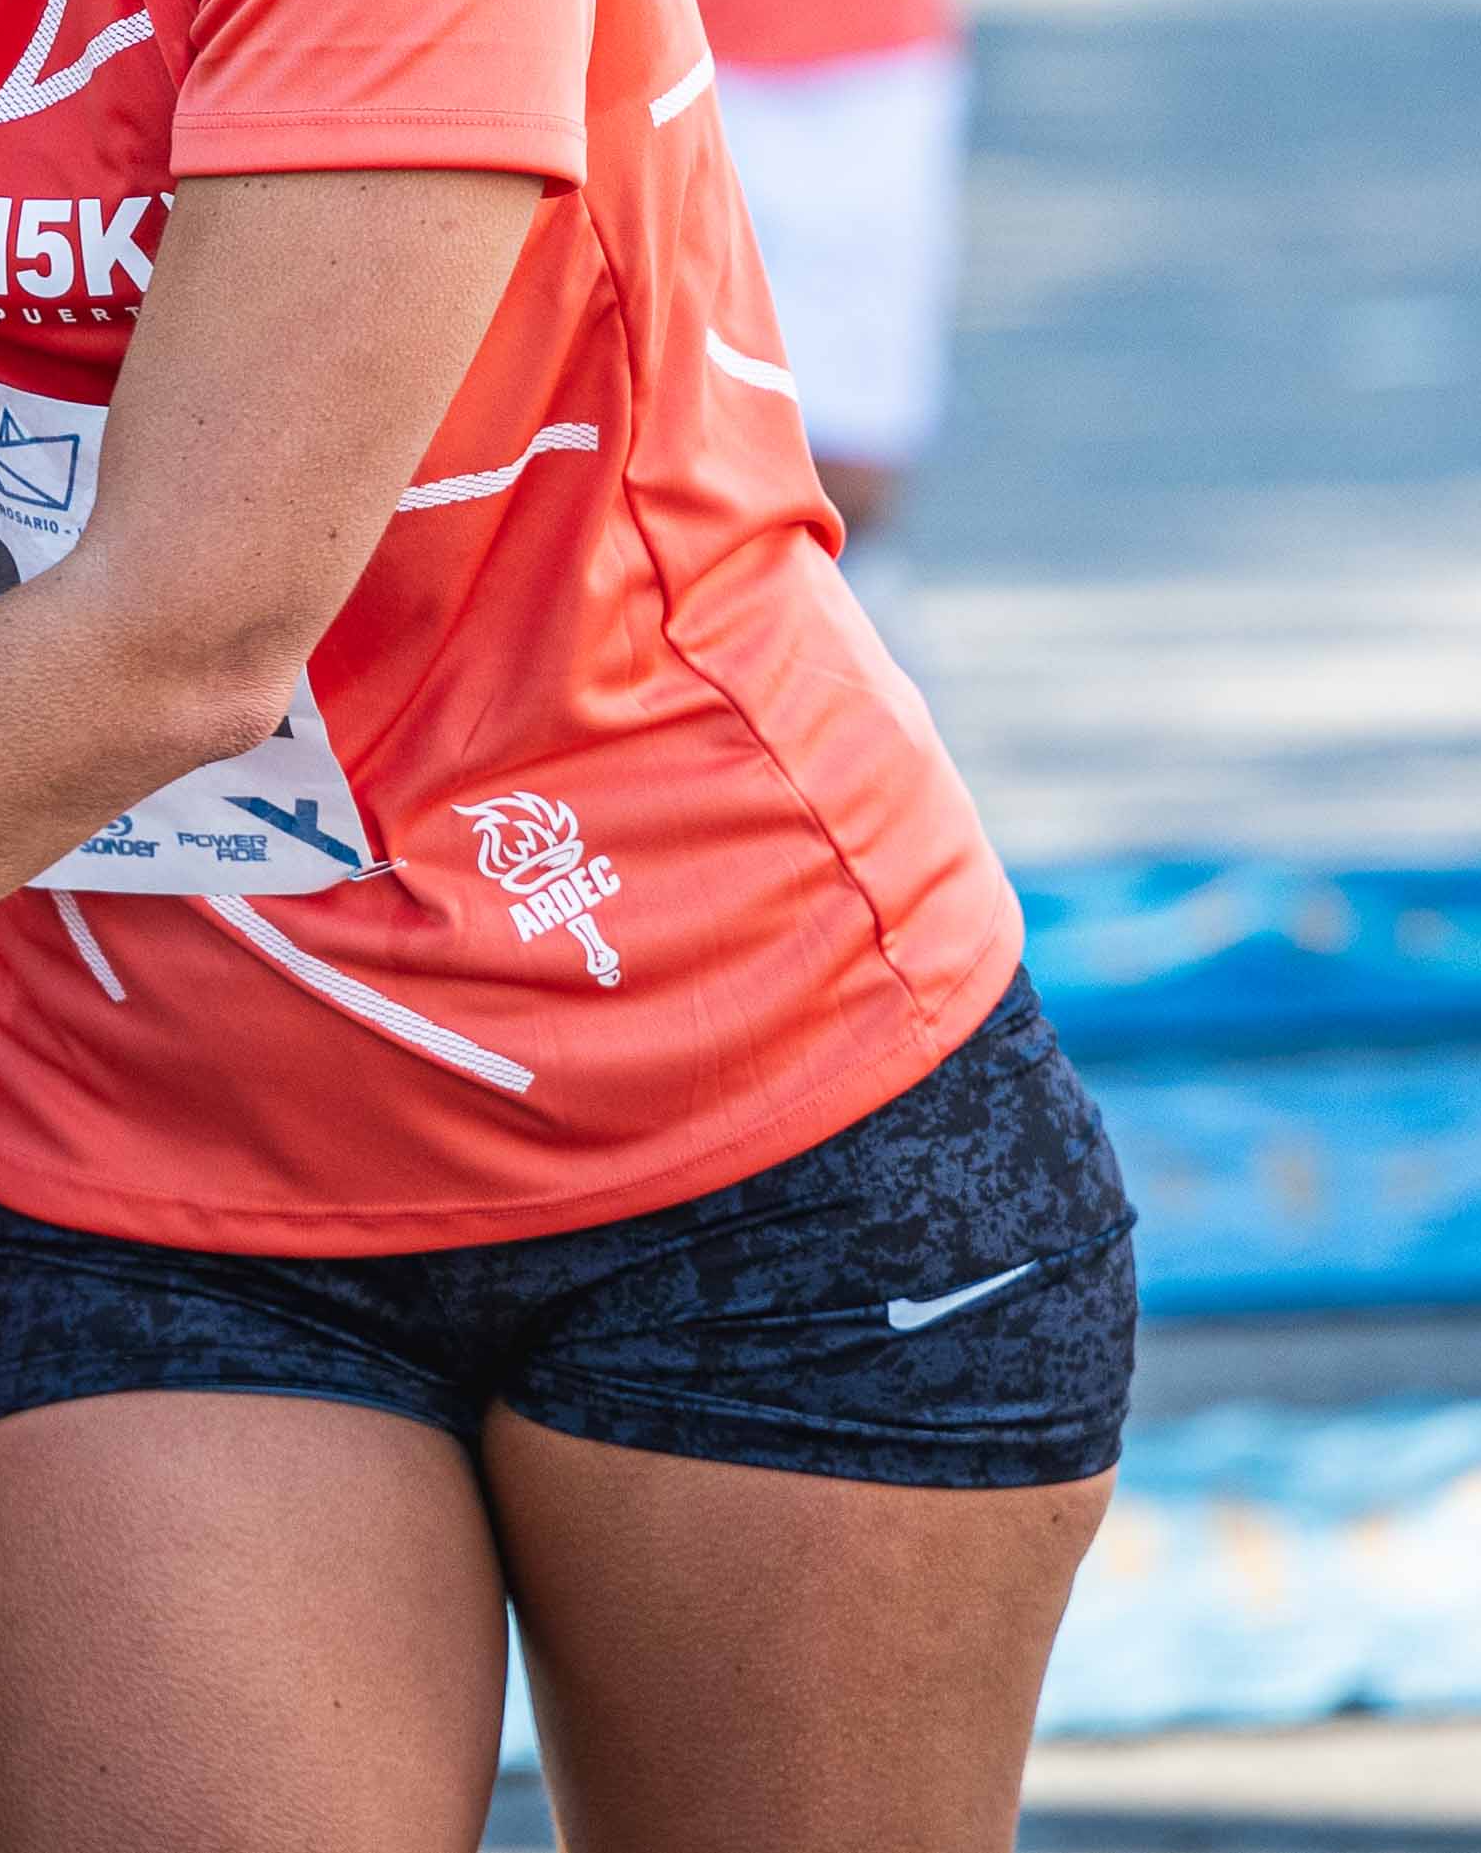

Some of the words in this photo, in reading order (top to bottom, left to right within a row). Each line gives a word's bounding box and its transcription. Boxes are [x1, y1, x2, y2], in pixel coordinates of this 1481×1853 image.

[0, 504, 59, 535] ROSARIO
[176, 831, 269, 849] POWER
[508, 854, 621, 944] ARDEC
